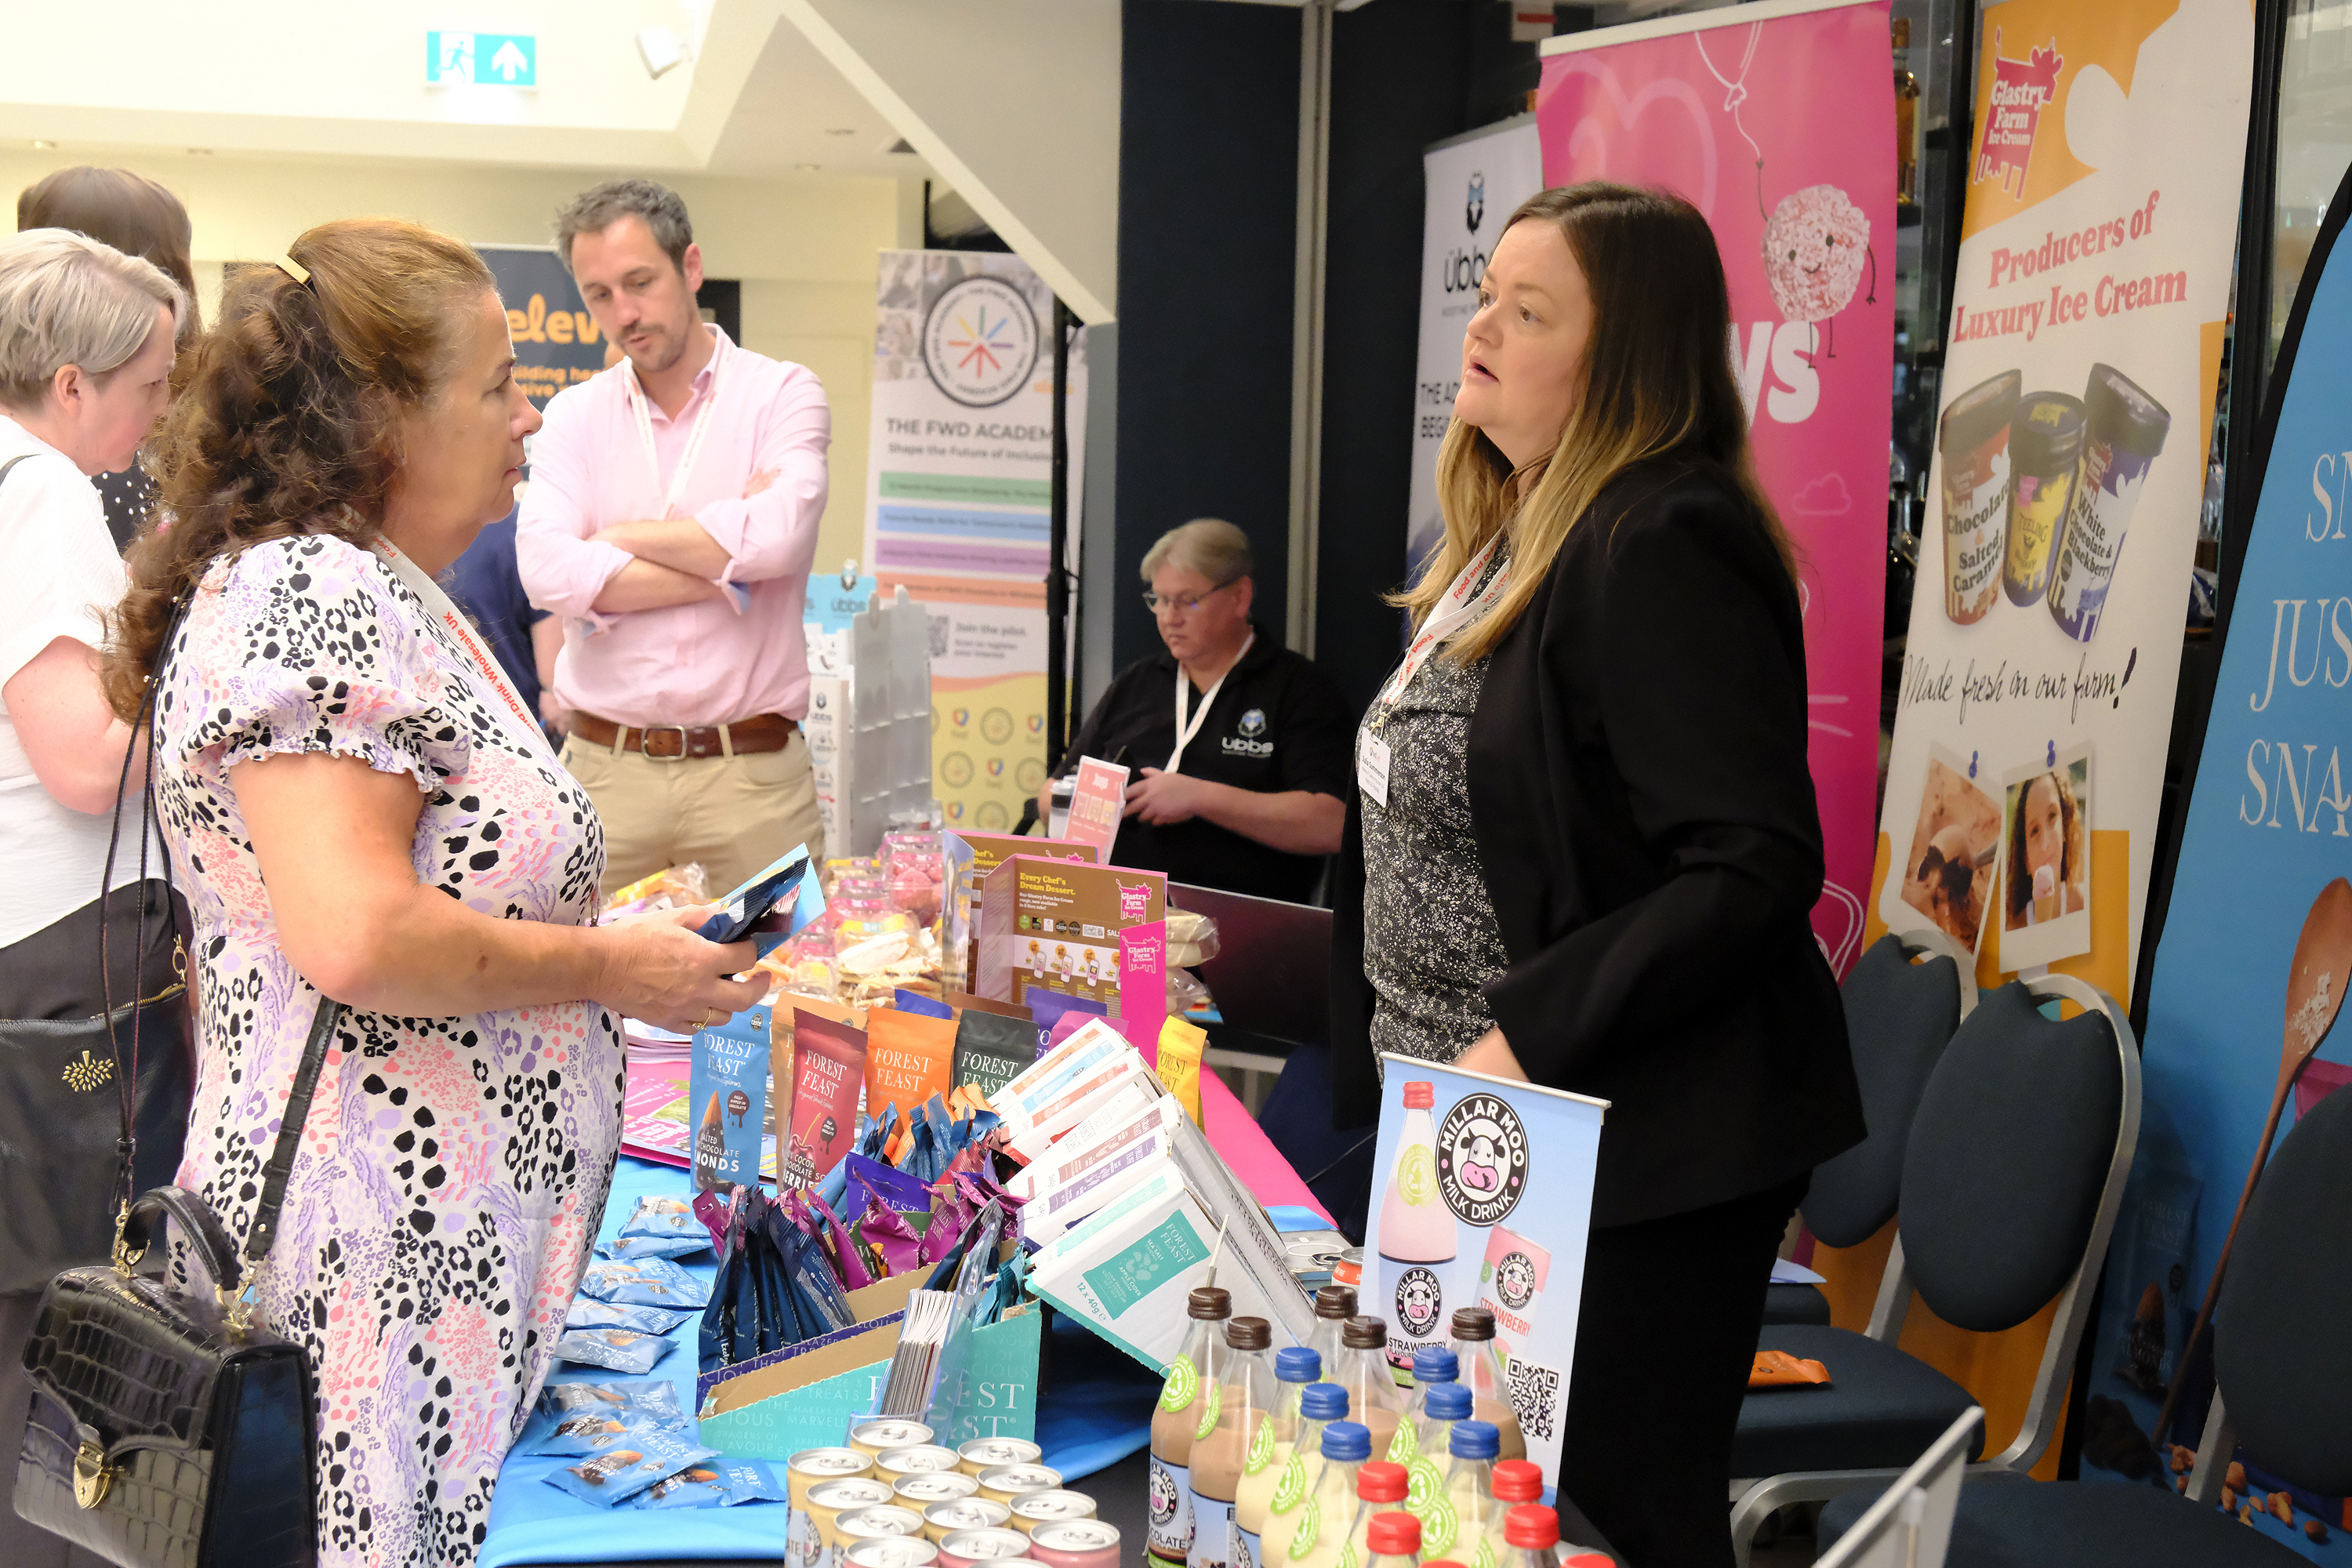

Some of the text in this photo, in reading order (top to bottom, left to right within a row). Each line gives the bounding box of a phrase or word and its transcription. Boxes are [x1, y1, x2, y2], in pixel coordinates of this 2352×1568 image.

[1991, 80, 2048, 111] Glastry
[1994, 107, 2029, 130] Farm
[1988, 129, 2031, 147] Ice Cream
[1988, 190, 2161, 289] Producers of
[1953, 270, 2187, 343] Luxury Ice Cream
[886, 417, 921, 436] THE
[925, 419, 971, 438] FWD
[887, 441, 1004, 459] Shape the Future of
[2078, 488, 2107, 542] White
[2070, 508, 2105, 559] Chocolate
[1959, 528, 1999, 571] Salted
[2067, 527, 2112, 582] Blackberry
[1454, 560, 1484, 600] Food and
[1411, 633, 1434, 654] Food
[442, 611, 459, 630] UK
[456, 628, 500, 681] Wholesale
[495, 681, 521, 715] Drink
[1903, 654, 1955, 710] Made
[1959, 658, 2007, 726] fresh
[2009, 670, 2031, 697] on
[2034, 668, 2067, 701] our
[1019, 881, 1076, 895] Dream Dessert.
[1020, 873, 1066, 885] Every Chef's
[1121, 893, 1147, 902] Glastry
[805, 1050, 848, 1082] FOREST
[875, 1047, 933, 1074] FOREST
[961, 1051, 1018, 1079] FOREST
[801, 1069, 839, 1100] FEAST
[877, 1068, 924, 1092] FEAST
[1440, 1100, 1525, 1167] MILLAR MOO
[700, 1142, 740, 1159] CHOCOLATE
[794, 1154, 816, 1170] COCOA
[1443, 1174, 1515, 1221] MILK DRINK
[1153, 1248, 1163, 1261] SALT
[1160, 1232, 1186, 1263] FEAST
[1166, 1222, 1196, 1261] FOREST
[1118, 1265, 1142, 1298] APPLE CIDER
[1500, 1253, 1534, 1289] MILLAR MOO
[1076, 1282, 1085, 1294] 12
[1088, 1298, 1100, 1316] 40g
[1398, 1270, 1440, 1302] MILLAR MOO
[1497, 1283, 1528, 1308] MILK DRINK
[1399, 1312, 1438, 1334] MILK DRINK
[1480, 1297, 1531, 1338] STRAWBERRY
[1186, 1366, 1196, 1388] BOTTLE
[767, 1400, 790, 1411] THE
[808, 1388, 859, 1402] TREATS
[1170, 1396, 1188, 1409] LABEL
[642, 1436, 681, 1459] FEAST
[1161, 1472, 1177, 1501] MOO
[1154, 1508, 1174, 1524] DRINK
